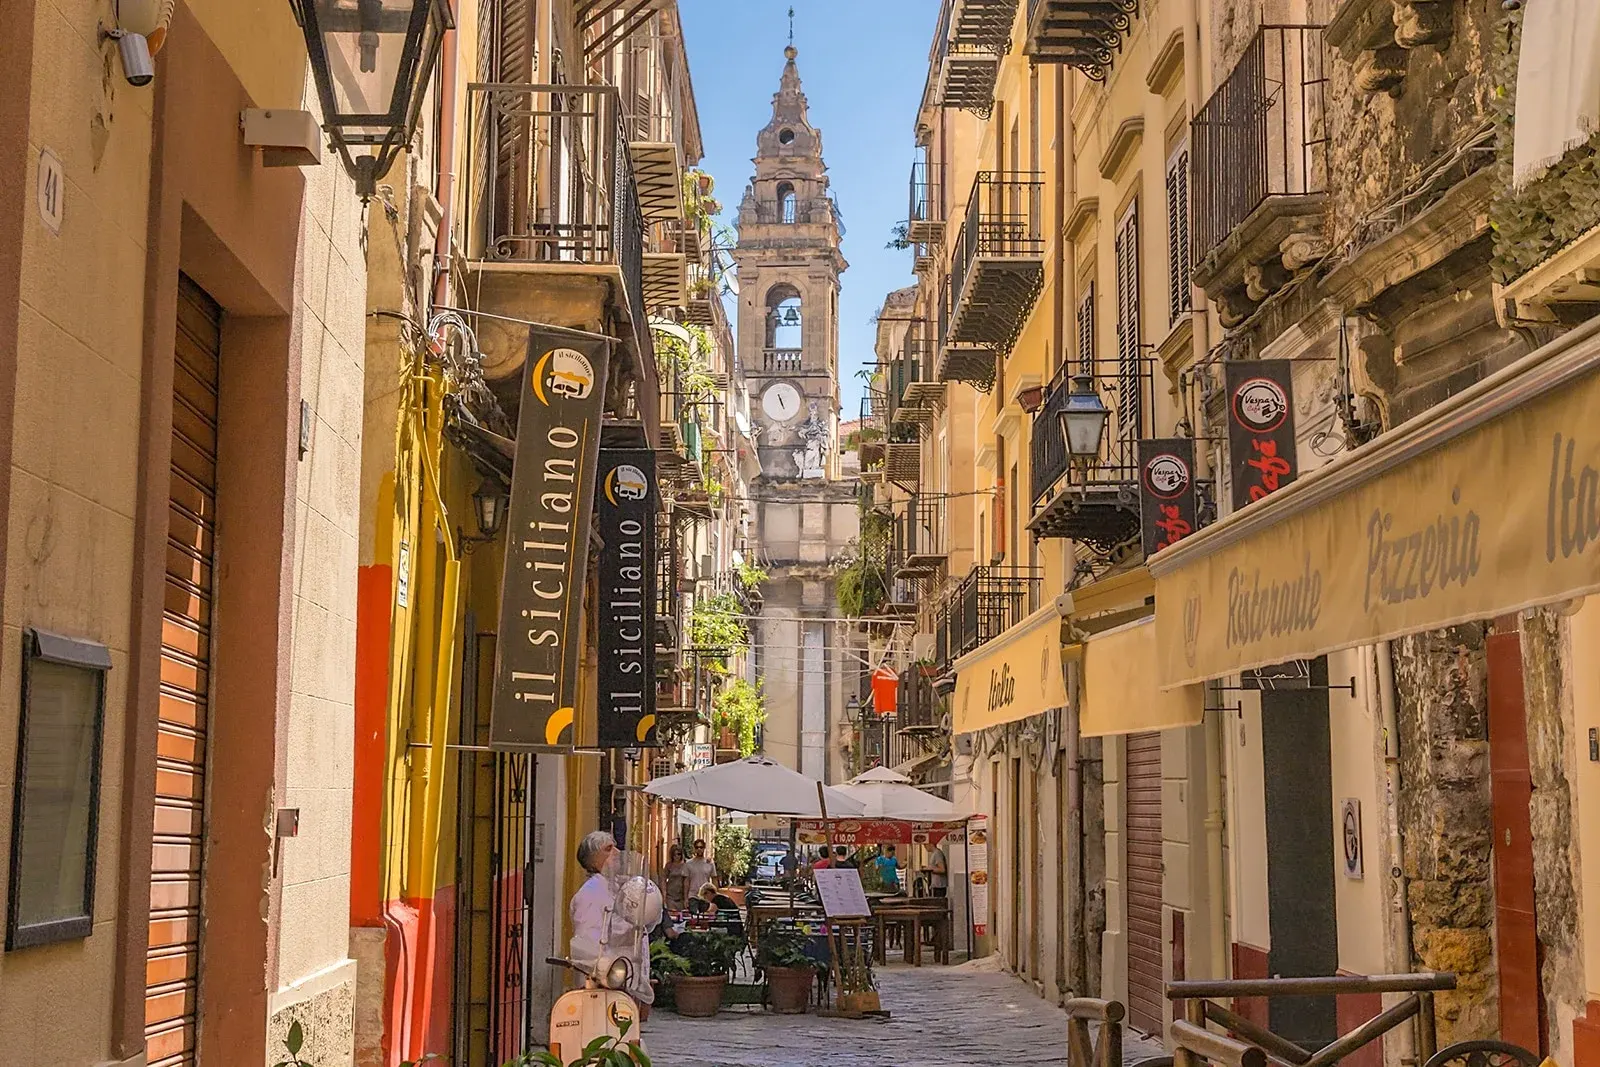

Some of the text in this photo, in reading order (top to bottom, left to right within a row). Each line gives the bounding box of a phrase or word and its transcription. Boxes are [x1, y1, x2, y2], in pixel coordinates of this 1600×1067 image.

[45, 165, 58, 218] 41
[1245, 395, 1270, 407] Vespa
[1154, 468, 1175, 477] Vespa
[511, 426, 579, 703] il siciliano
[1226, 549, 1321, 650] Ristorante
[1364, 484, 1482, 613] Pizzeria
[610, 519, 642, 714] il siciliano
[987, 662, 1015, 712] Italia
